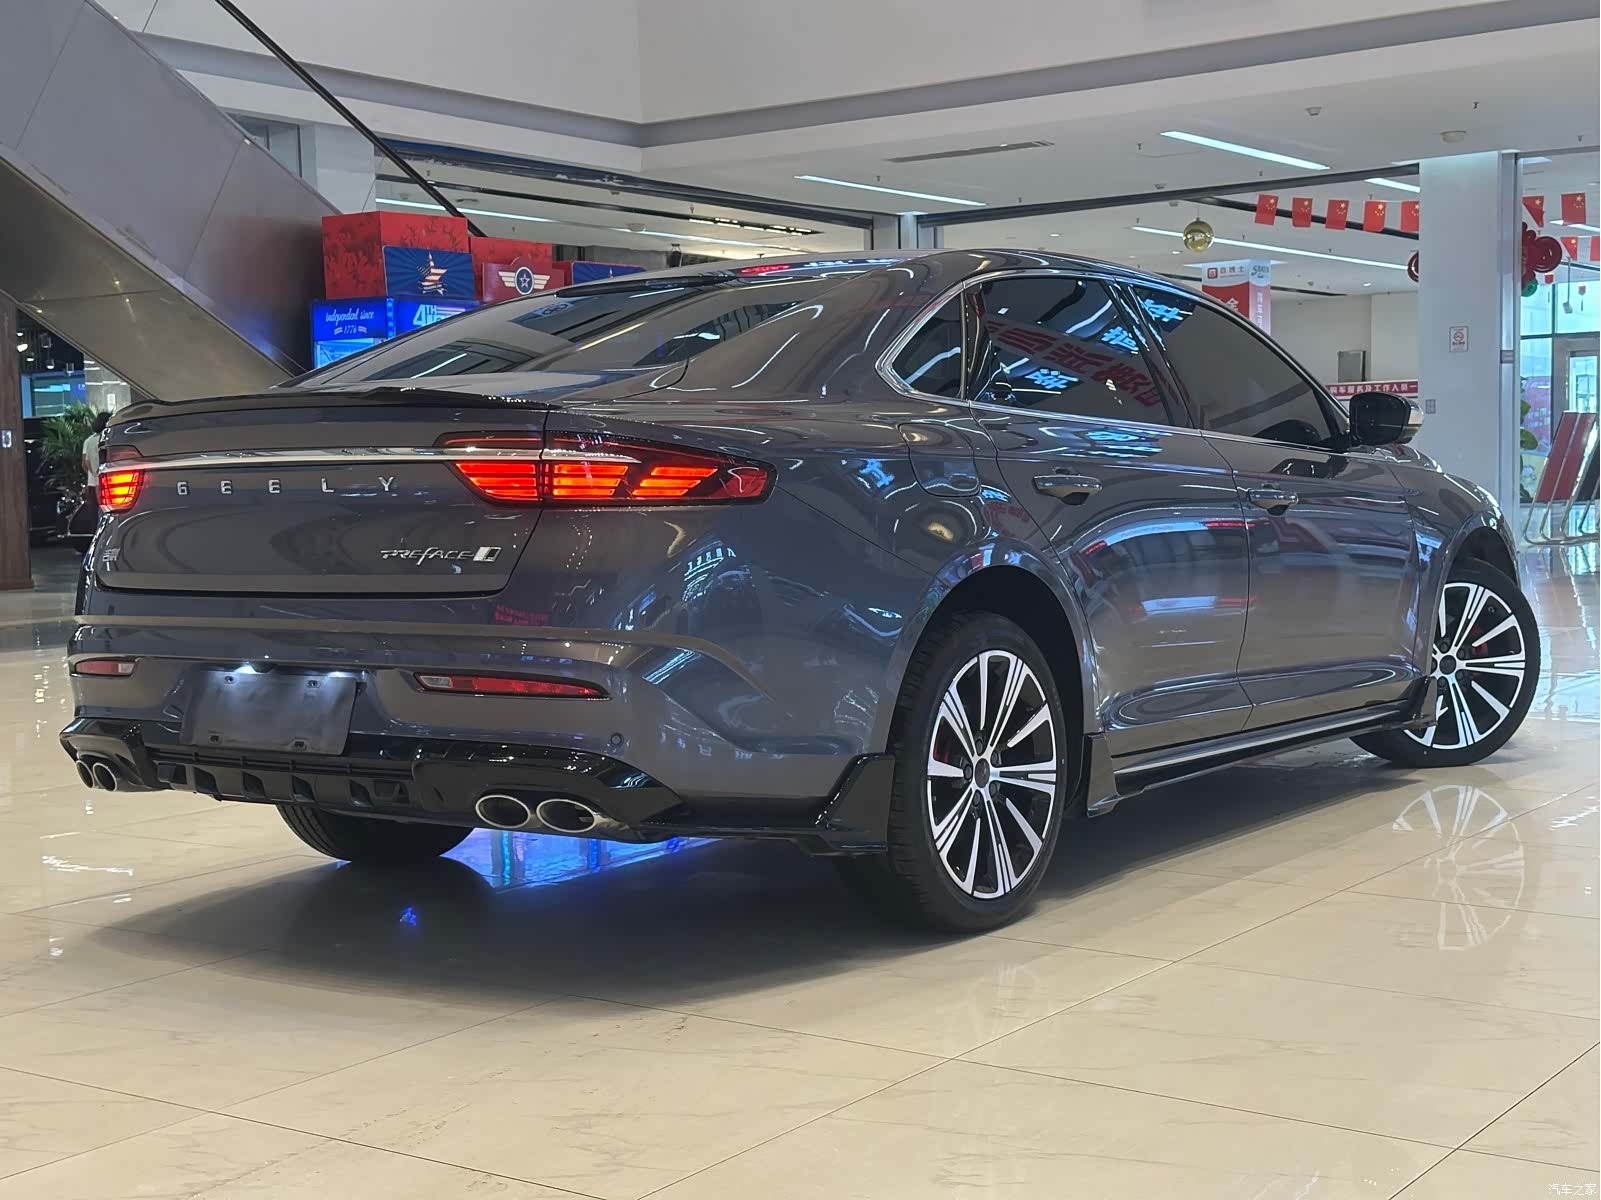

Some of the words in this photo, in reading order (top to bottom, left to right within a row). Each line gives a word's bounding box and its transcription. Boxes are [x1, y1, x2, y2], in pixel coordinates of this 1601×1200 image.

[360, 310, 374, 320] since
[412, 304, 437, 326] 4TH
[343, 325, 357, 334] 1776
[177, 476, 394, 495] GEELY
